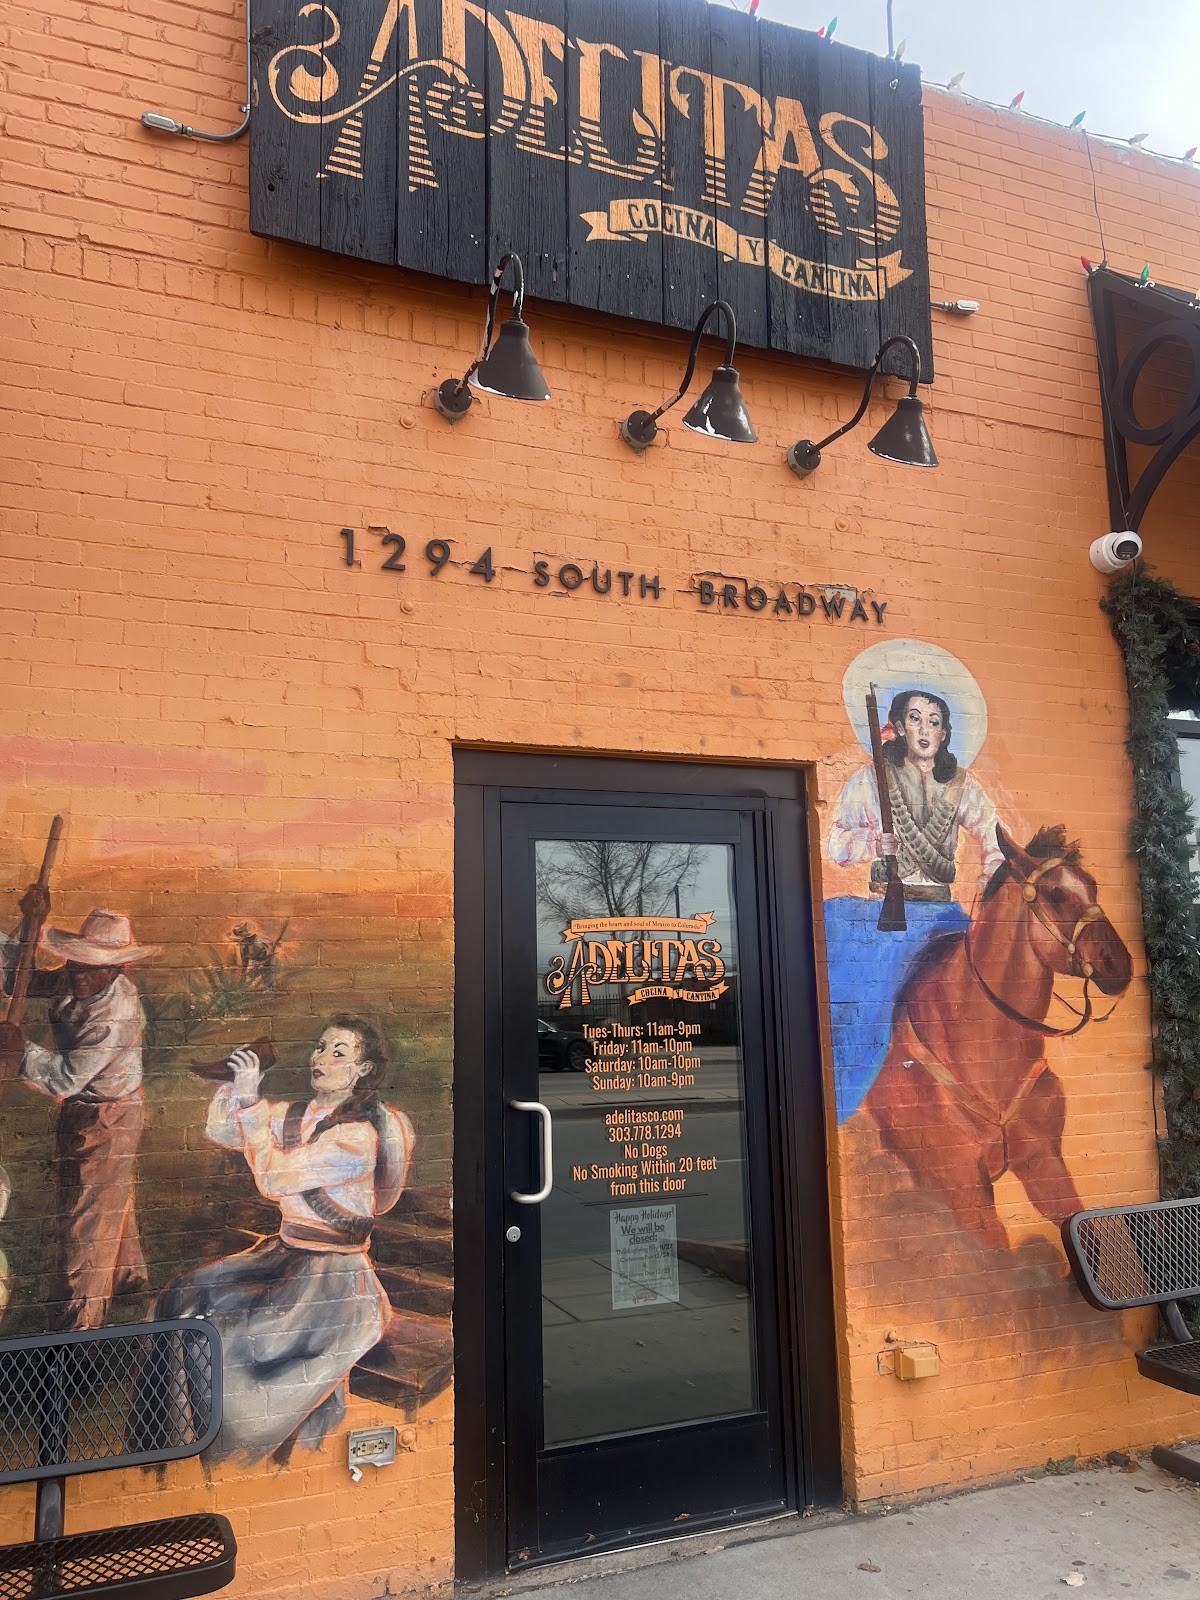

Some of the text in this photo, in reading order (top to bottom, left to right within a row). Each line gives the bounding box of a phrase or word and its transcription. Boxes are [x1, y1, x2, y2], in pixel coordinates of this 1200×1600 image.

[268, 0, 901, 245] ADELITAS
[628, 203, 875, 297] COCINA Y CANTINA
[339, 528, 888, 624] 1294 SOUTH BROADWAY
[546, 939, 725, 1010] ADELITAS
[640, 987, 717, 1001] COCINA Y CANTINA
[582, 1021, 701, 1039] Tues-Thurs: 11am-9pm
[593, 1038, 692, 1056] Friday: 11am-10pm
[584, 1055, 701, 1074] Saturday: 10am-10pm
[592, 1072, 694, 1090] Sunday: 10am-9pm
[605, 1109, 684, 1125] adelitasco.com
[608, 1124, 681, 1142] 303.778.1294
[624, 1143, 667, 1159] No Dogs
[573, 1156, 717, 1181] No Smoking Within 20 feet
[610, 1177, 686, 1196] from this door
[614, 1207, 675, 1225] Happy Holidays!
[621, 1222, 665, 1235] We will be
